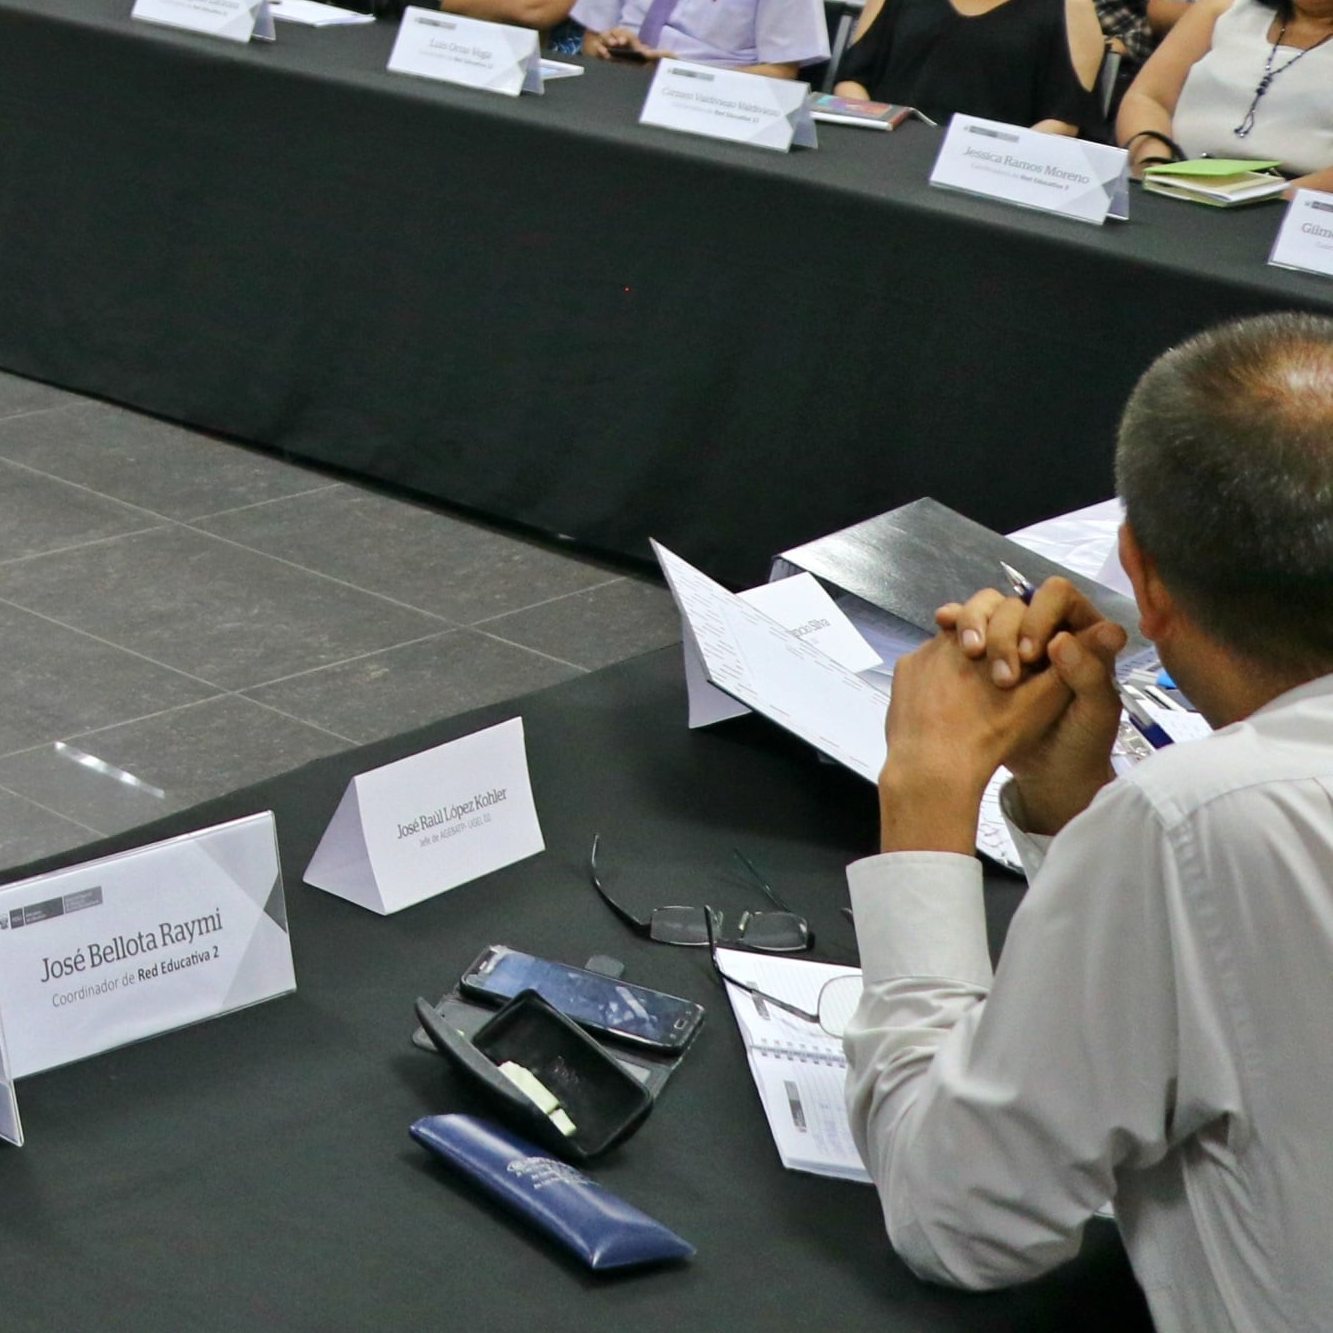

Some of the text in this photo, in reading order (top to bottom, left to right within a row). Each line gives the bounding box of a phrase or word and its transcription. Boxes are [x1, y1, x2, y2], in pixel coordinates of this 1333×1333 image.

[963, 146, 1091, 185] Jessica Ramos Moreno
[397, 819, 421, 839] José
[444, 801, 474, 821] López
[474, 789, 507, 809] Kohler
[41, 907, 223, 983] José Bellota Raymi
[52, 945, 219, 1007] Coordinador de Red Educativa 2
